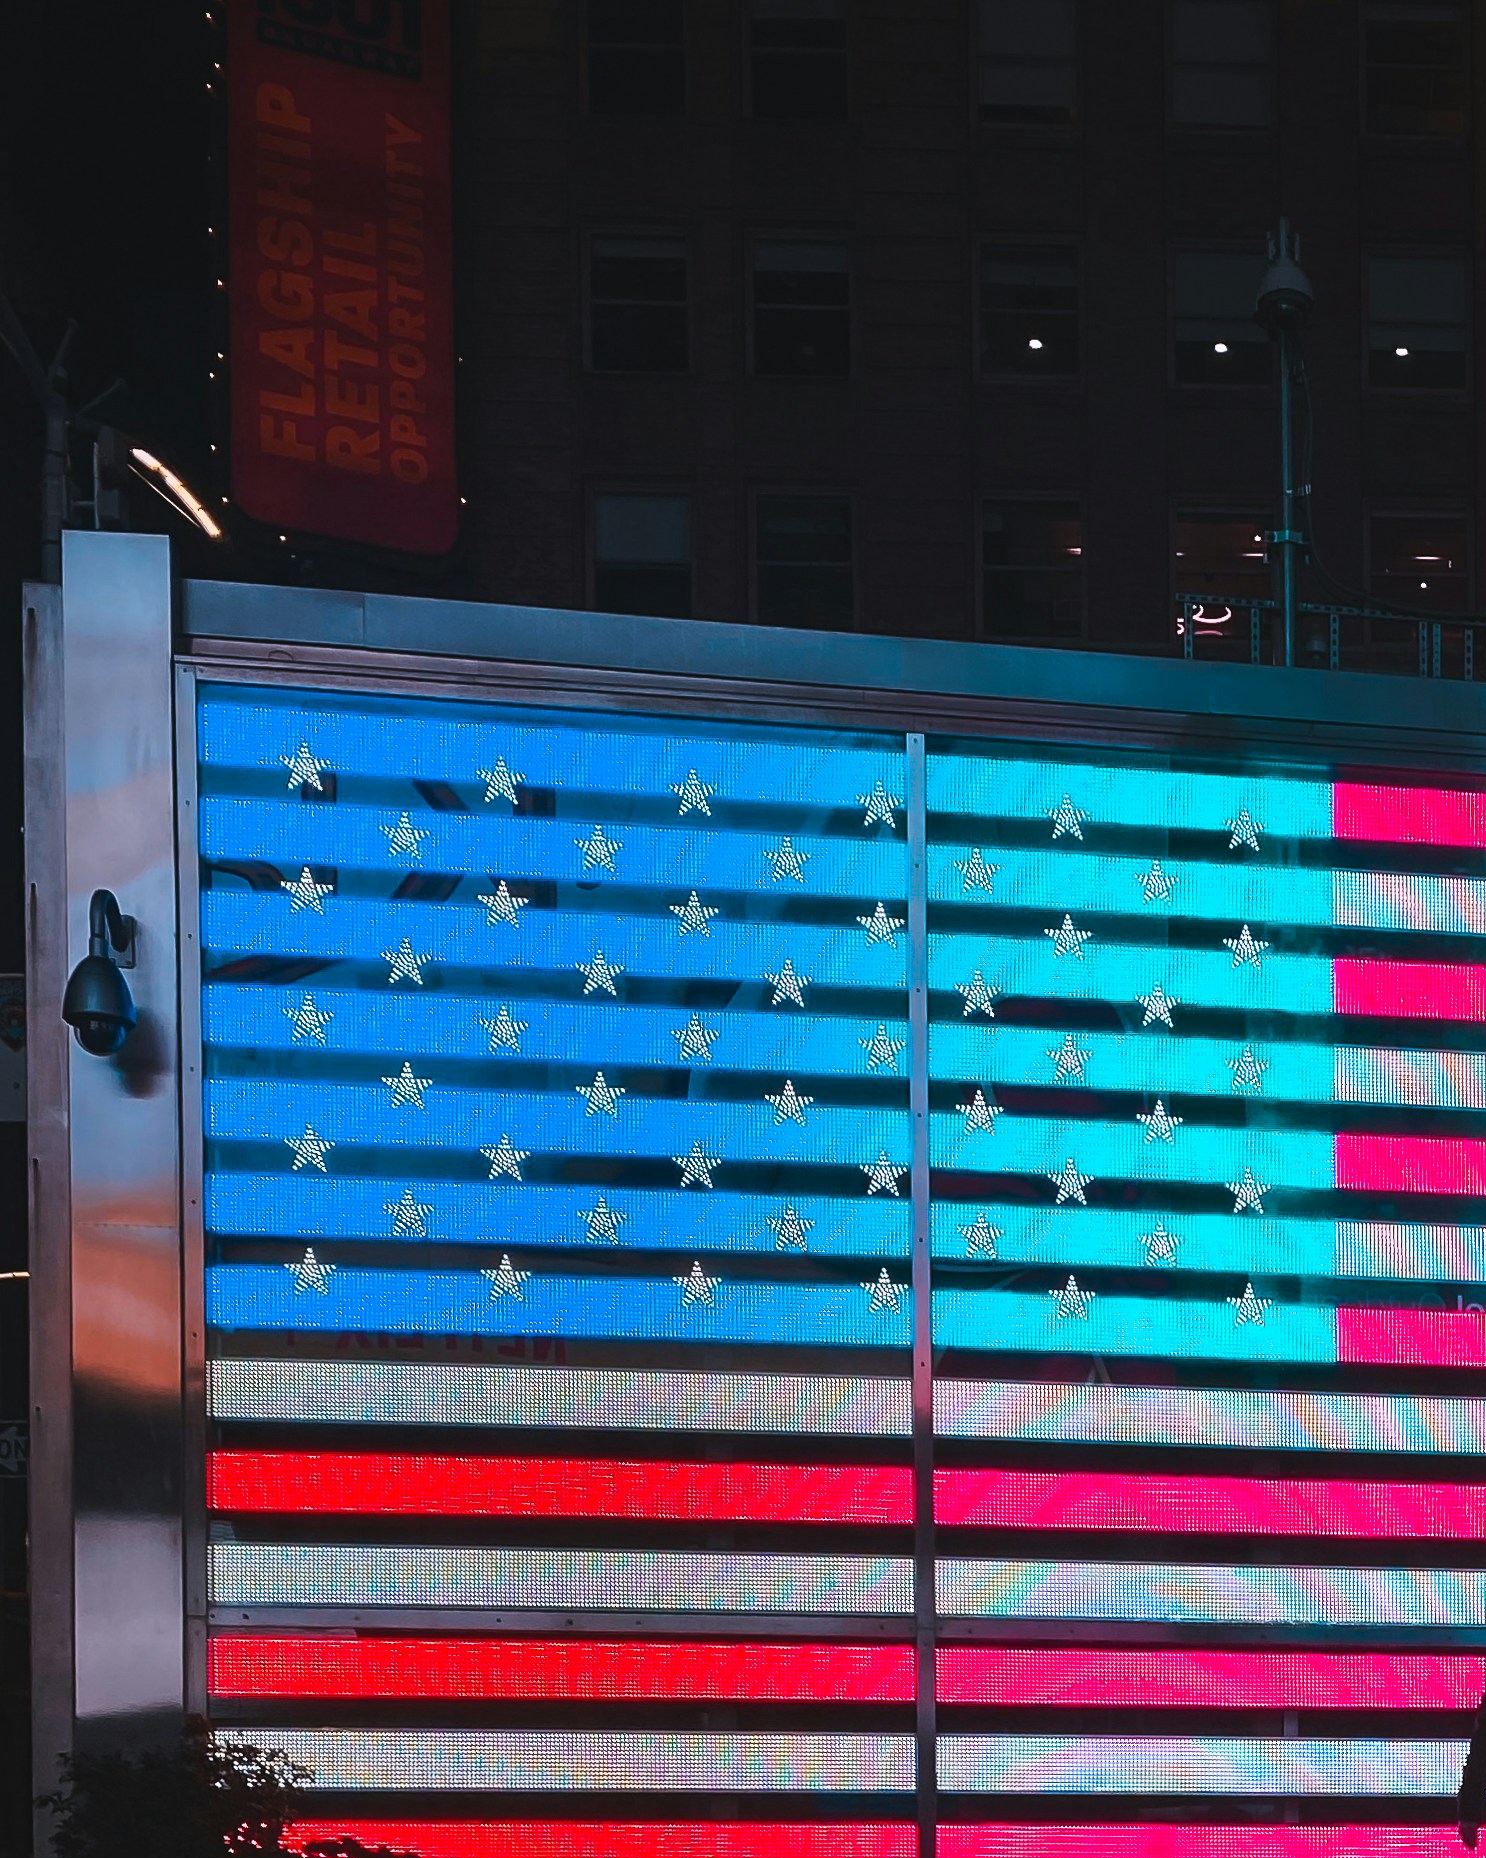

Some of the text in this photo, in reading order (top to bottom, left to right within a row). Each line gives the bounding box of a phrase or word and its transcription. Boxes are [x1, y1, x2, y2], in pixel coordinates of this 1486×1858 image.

[256, 82, 316, 462] FLAGSHIP
[323, 222, 381, 475] RETAIL
[385, 113, 428, 485] OPPORTUNITY
